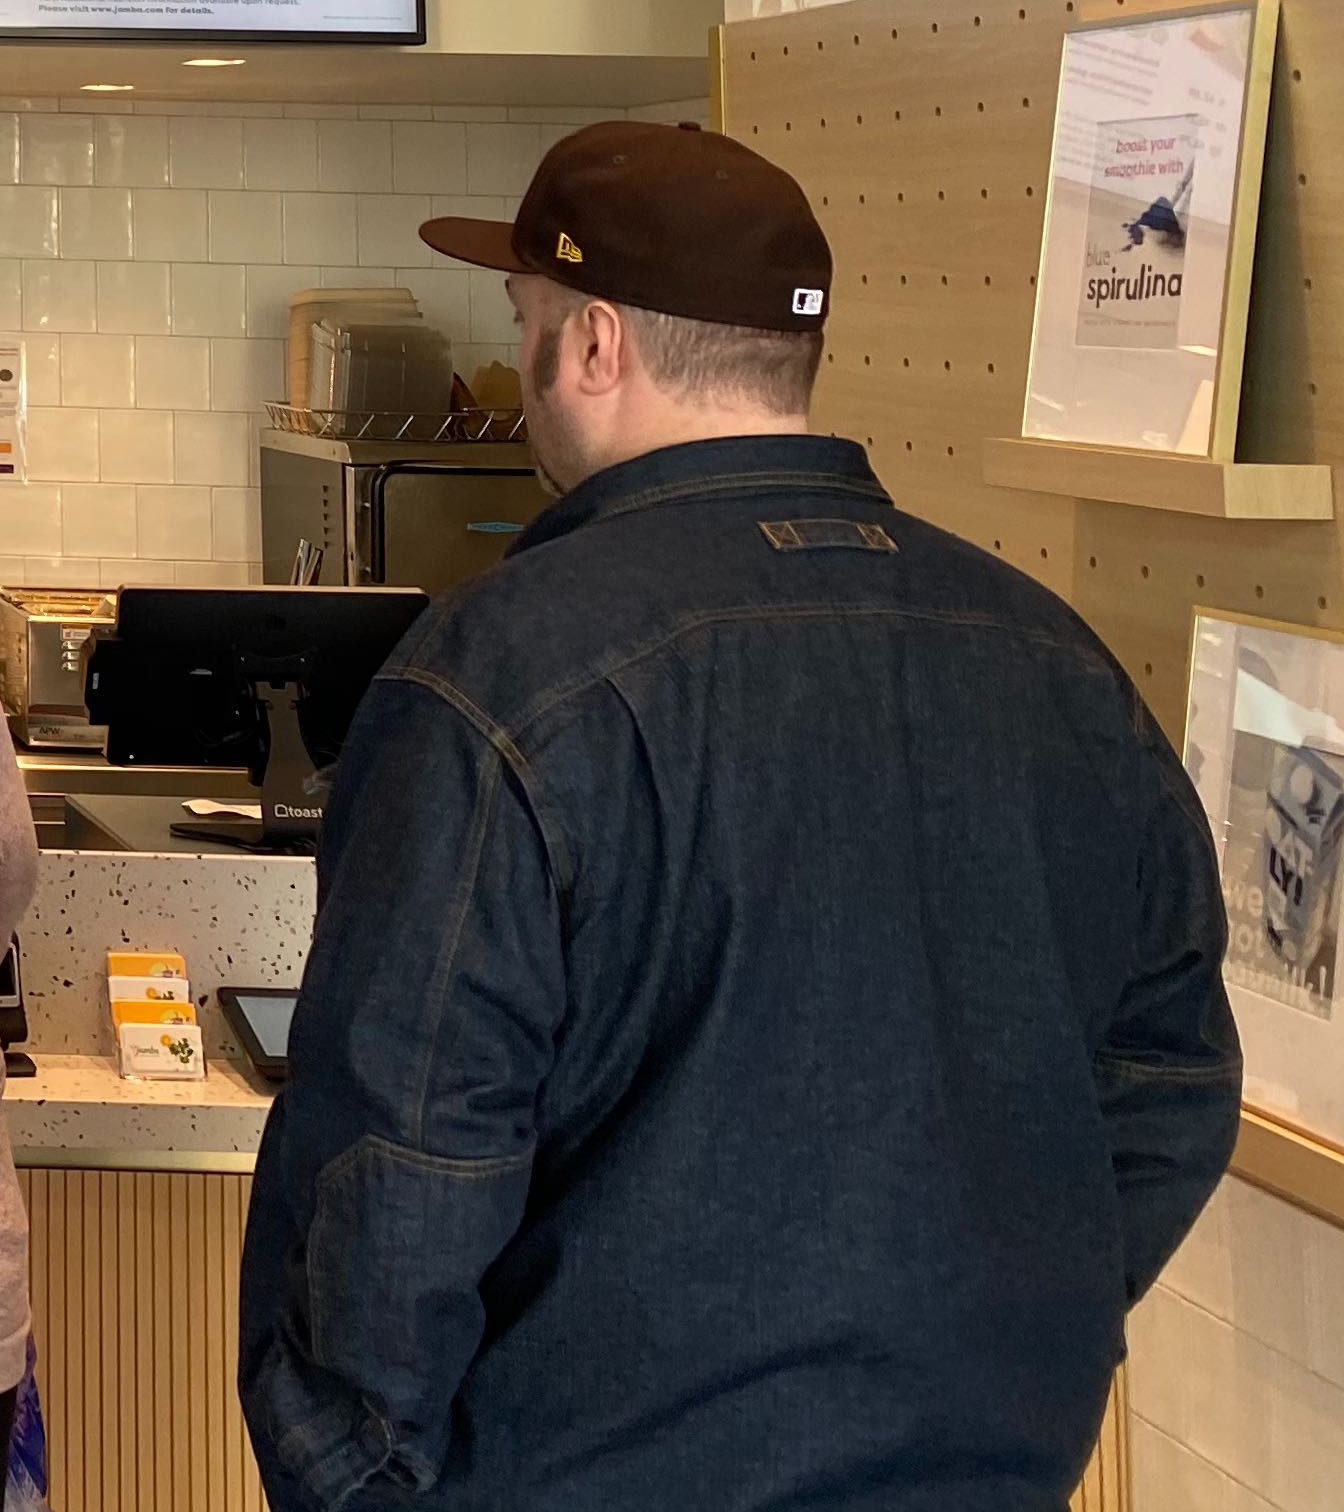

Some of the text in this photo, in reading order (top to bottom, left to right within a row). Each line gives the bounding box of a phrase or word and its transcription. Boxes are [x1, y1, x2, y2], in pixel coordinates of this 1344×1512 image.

[1150, 138, 1176, 155] your
[1104, 159, 1184, 178] smoothie with
[1086, 242, 1111, 267] blue
[1087, 264, 1183, 308] spirulina
[288, 806, 323, 818] toast
